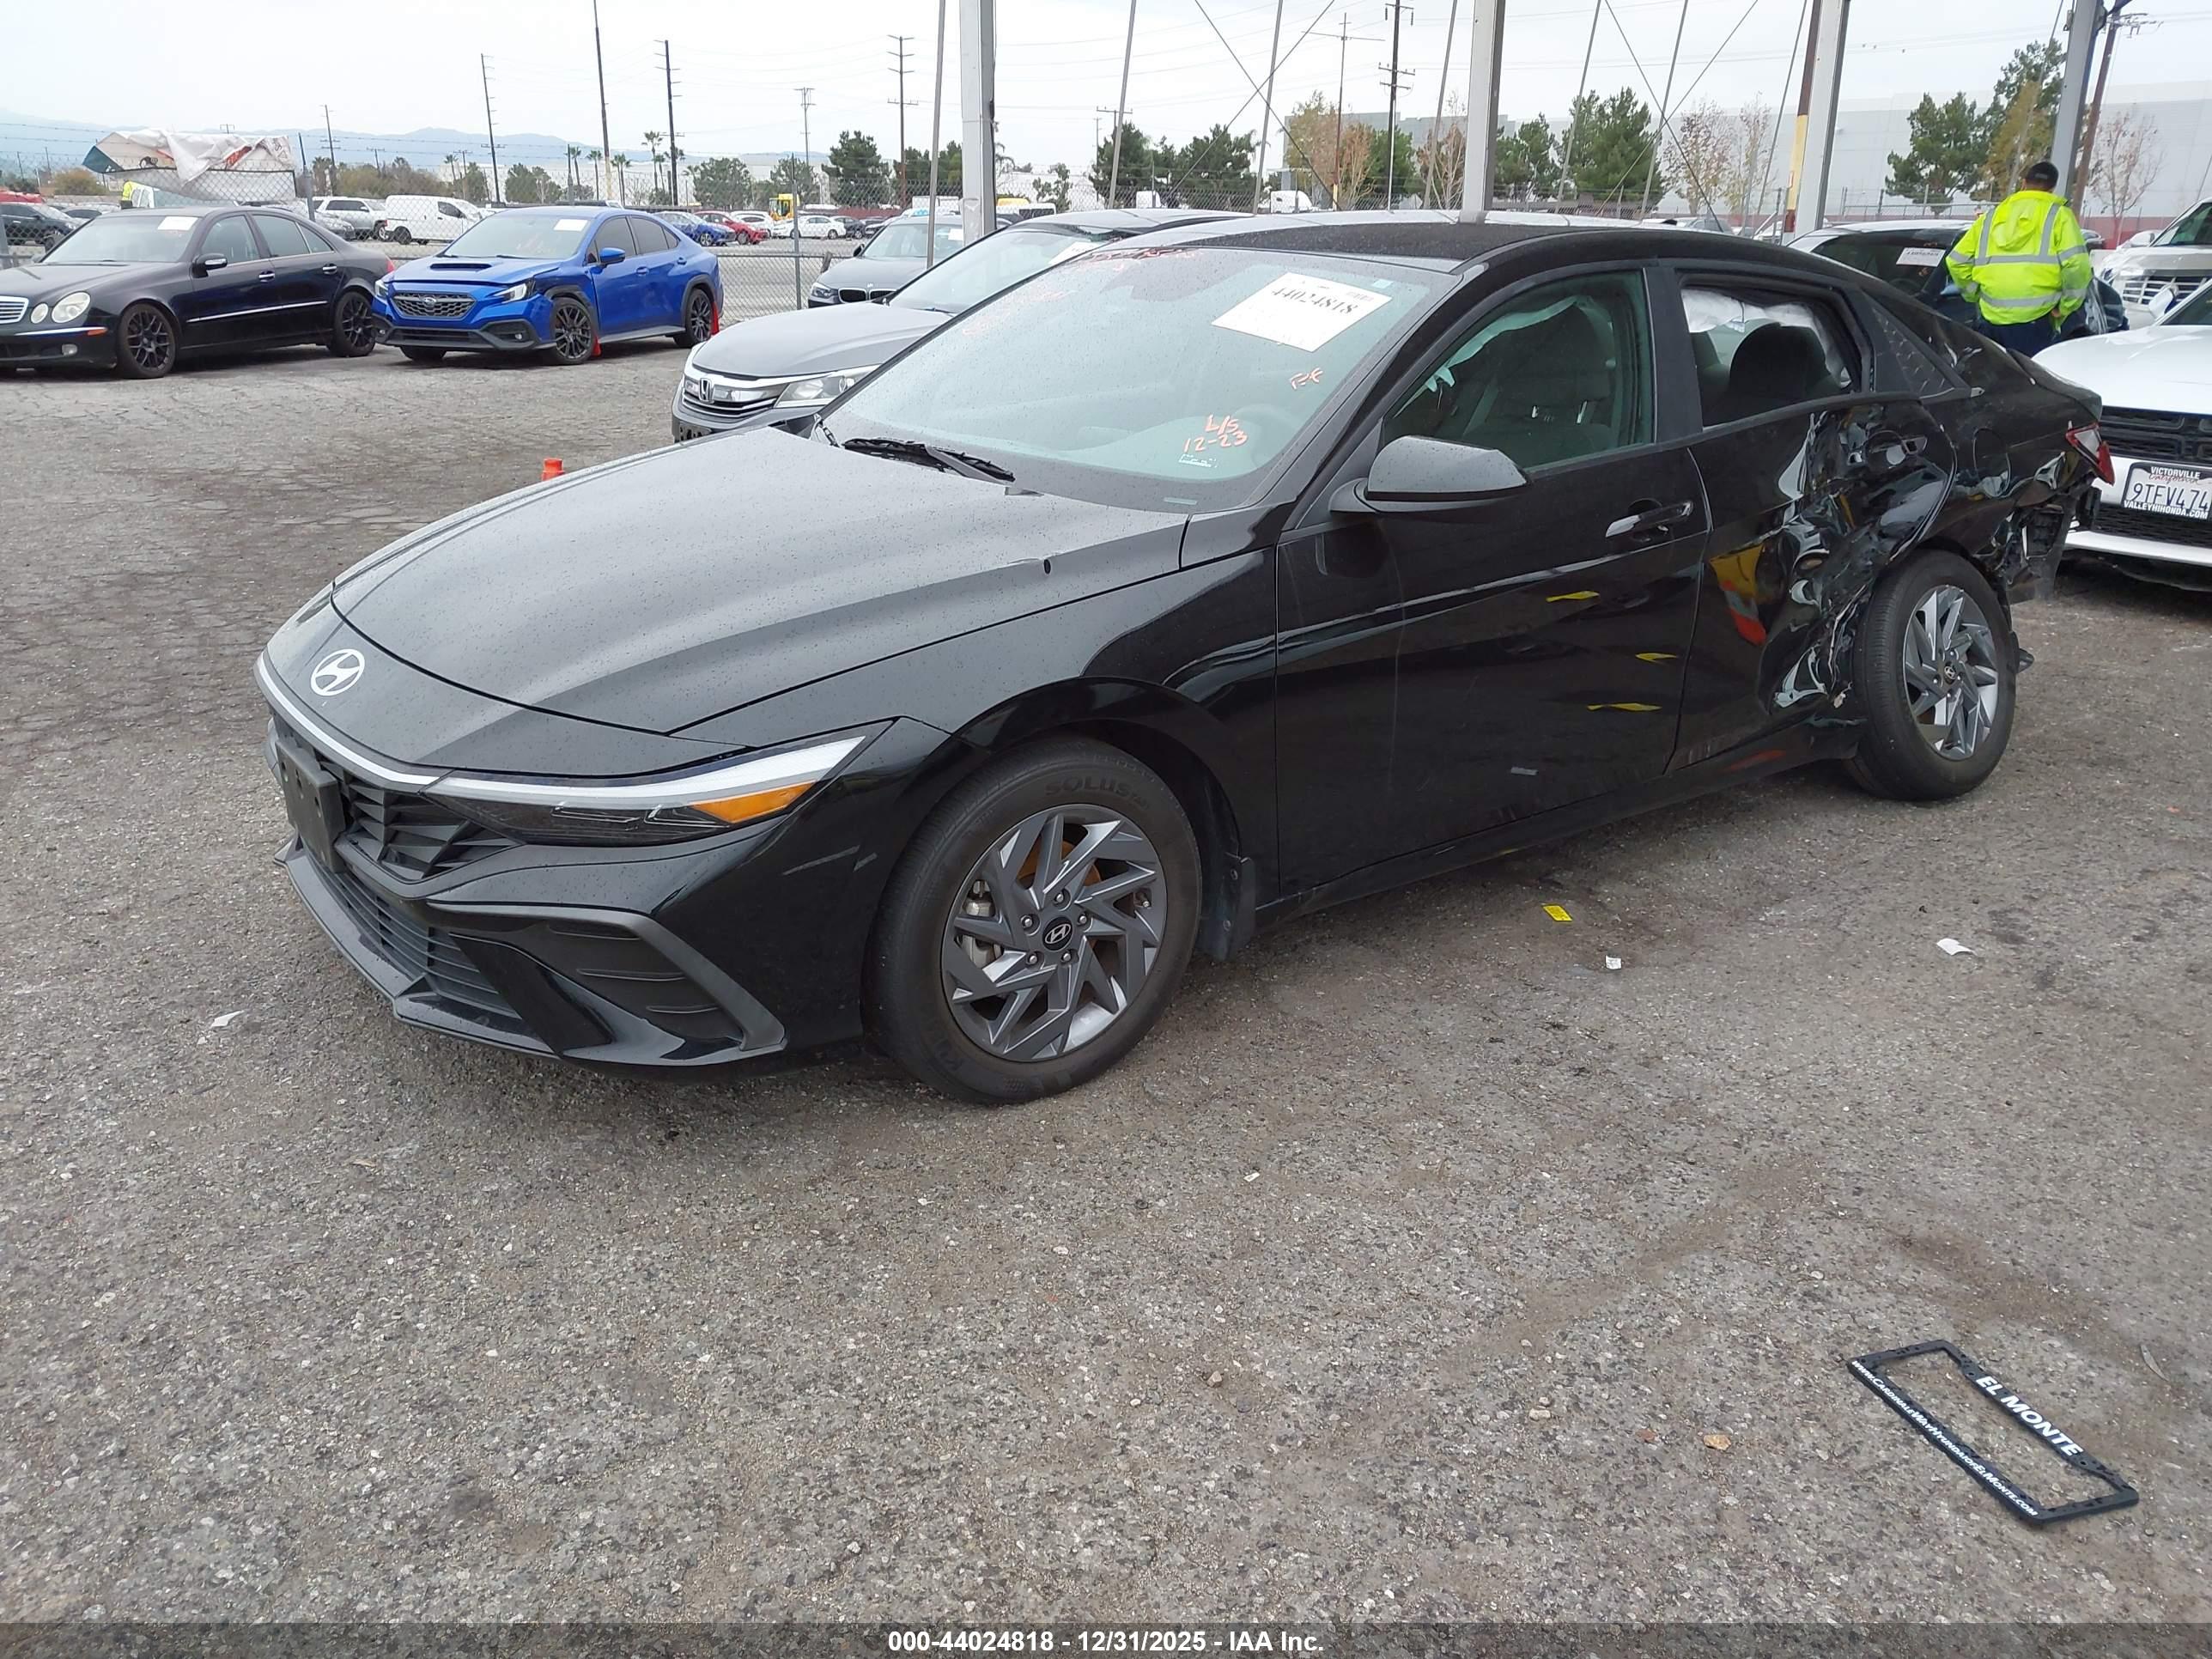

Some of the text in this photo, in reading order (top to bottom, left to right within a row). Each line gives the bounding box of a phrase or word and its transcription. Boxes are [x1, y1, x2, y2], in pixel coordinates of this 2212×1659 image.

[1271, 287, 1358, 313] 44024818
[1183, 430, 1249, 453] 12-23
[2150, 466, 2201, 480] VICTORVILLE
[2133, 483, 2209, 511] 9TFV474
[2123, 500, 2209, 520] VALLEYHIHONDA.COM
[1045, 775, 1130, 797] SOLUS
[1976, 1376, 2084, 1456] EL MONTE
